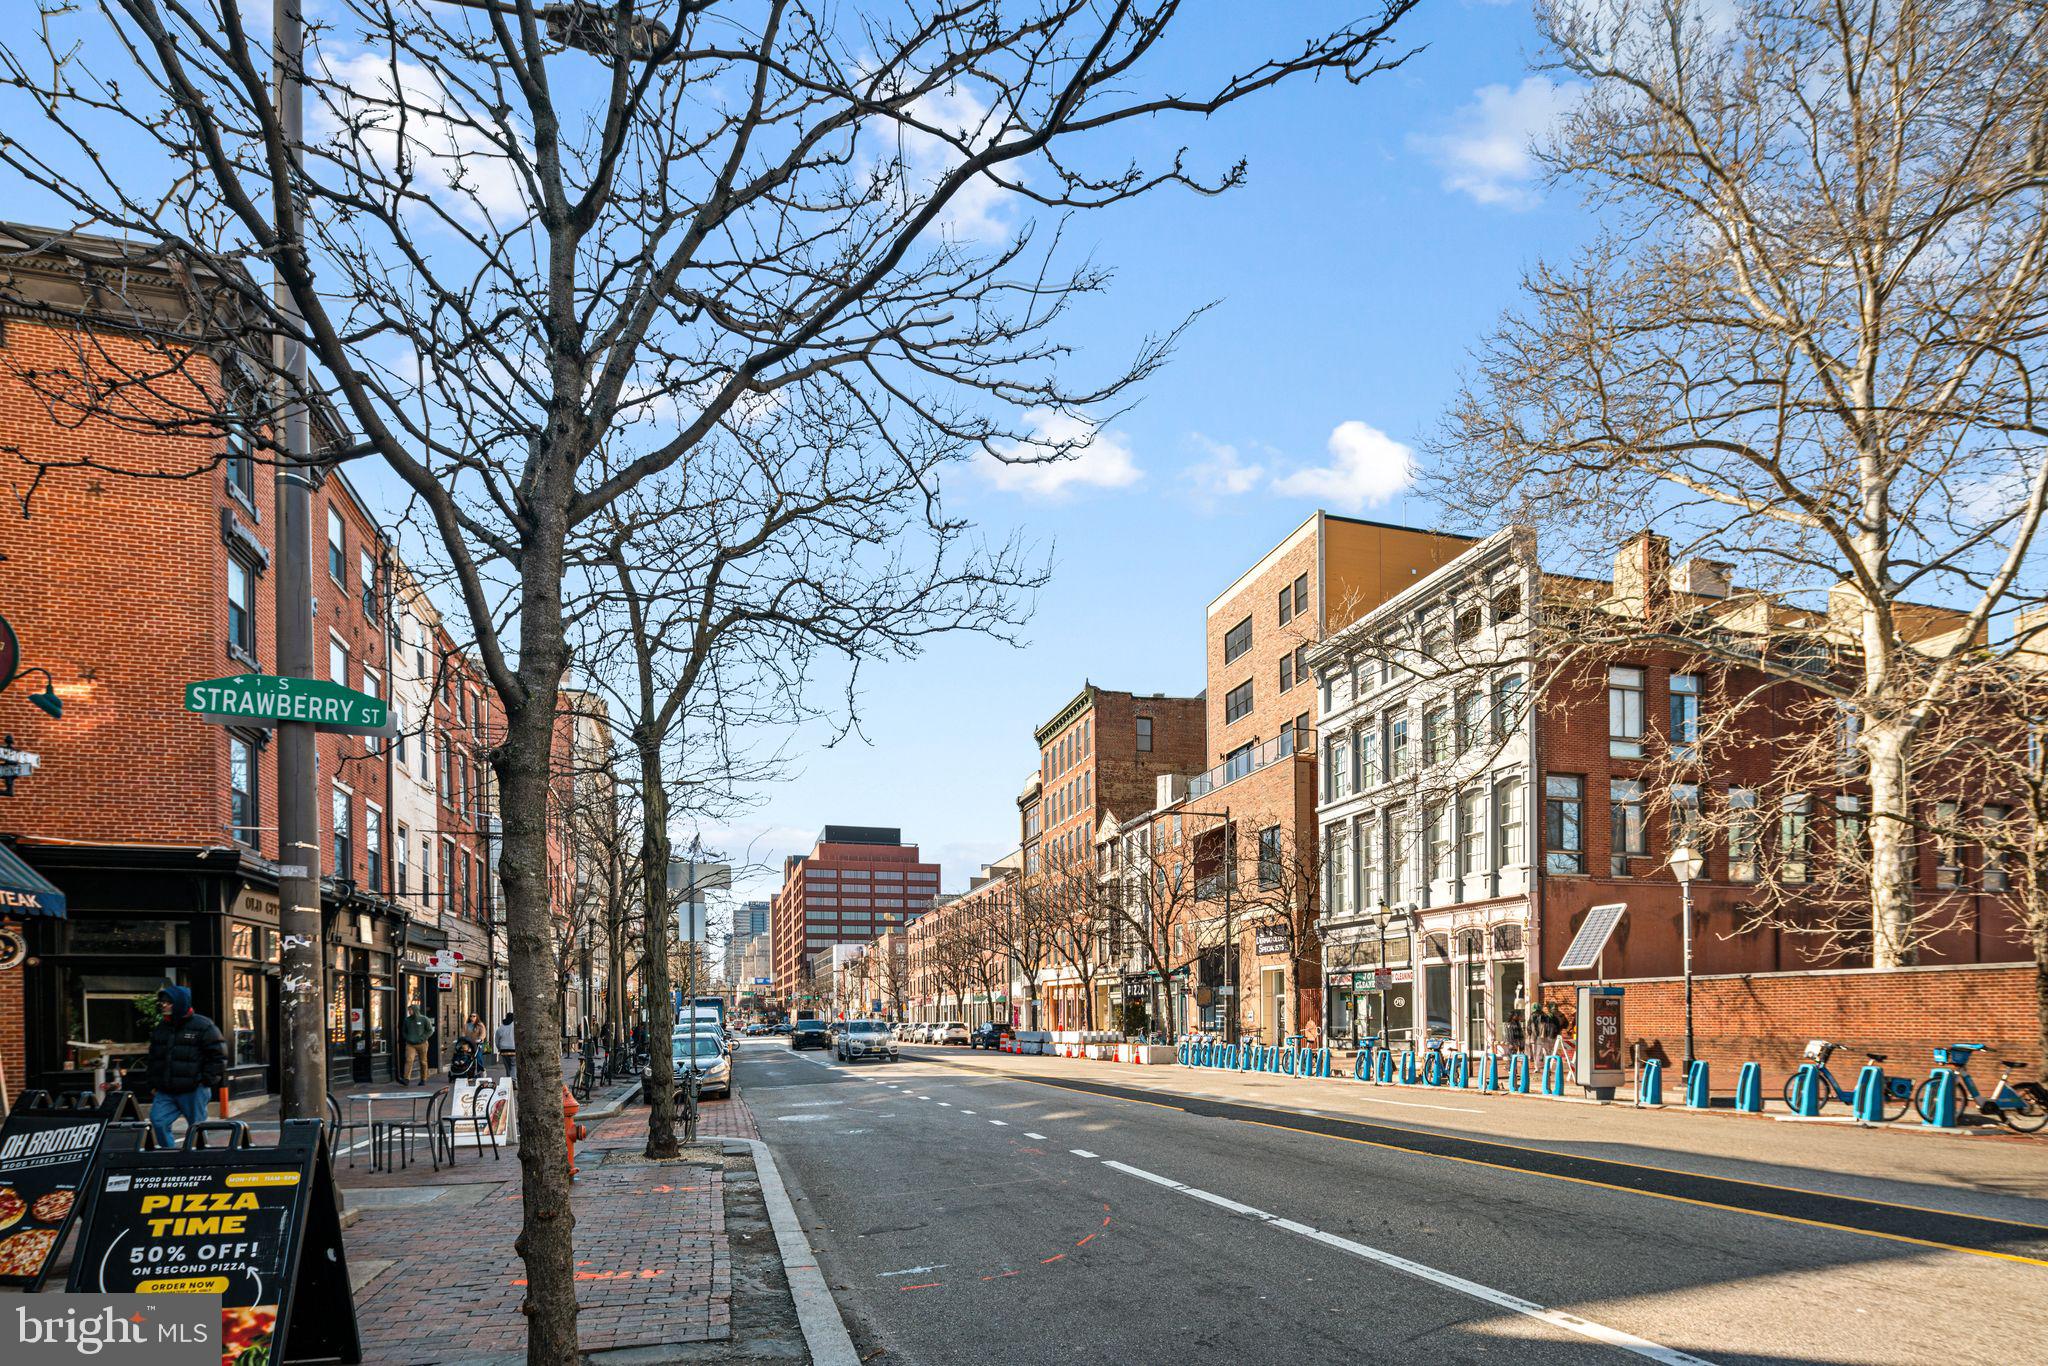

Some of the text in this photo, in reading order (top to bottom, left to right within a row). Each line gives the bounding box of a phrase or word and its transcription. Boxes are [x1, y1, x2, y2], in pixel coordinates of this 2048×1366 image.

[278, 678, 289, 690] S
[191, 686, 380, 724] STRAWBERRY ST
[0, 889, 42, 909] TEAK
[1596, 1016, 1617, 1026] SOU
[1602, 1026, 1617, 1035] ND
[0, 1122, 101, 1160] OH BROTHER
[140, 1192, 260, 1214] PIZZA
[147, 1215, 247, 1238] TIME
[129, 1242, 259, 1264] 50% OFF!
[132, 1262, 246, 1276] ON SECOND PIZZA
[151, 1282, 185, 1291] ORDER
[189, 1281, 215, 1289] NOW
